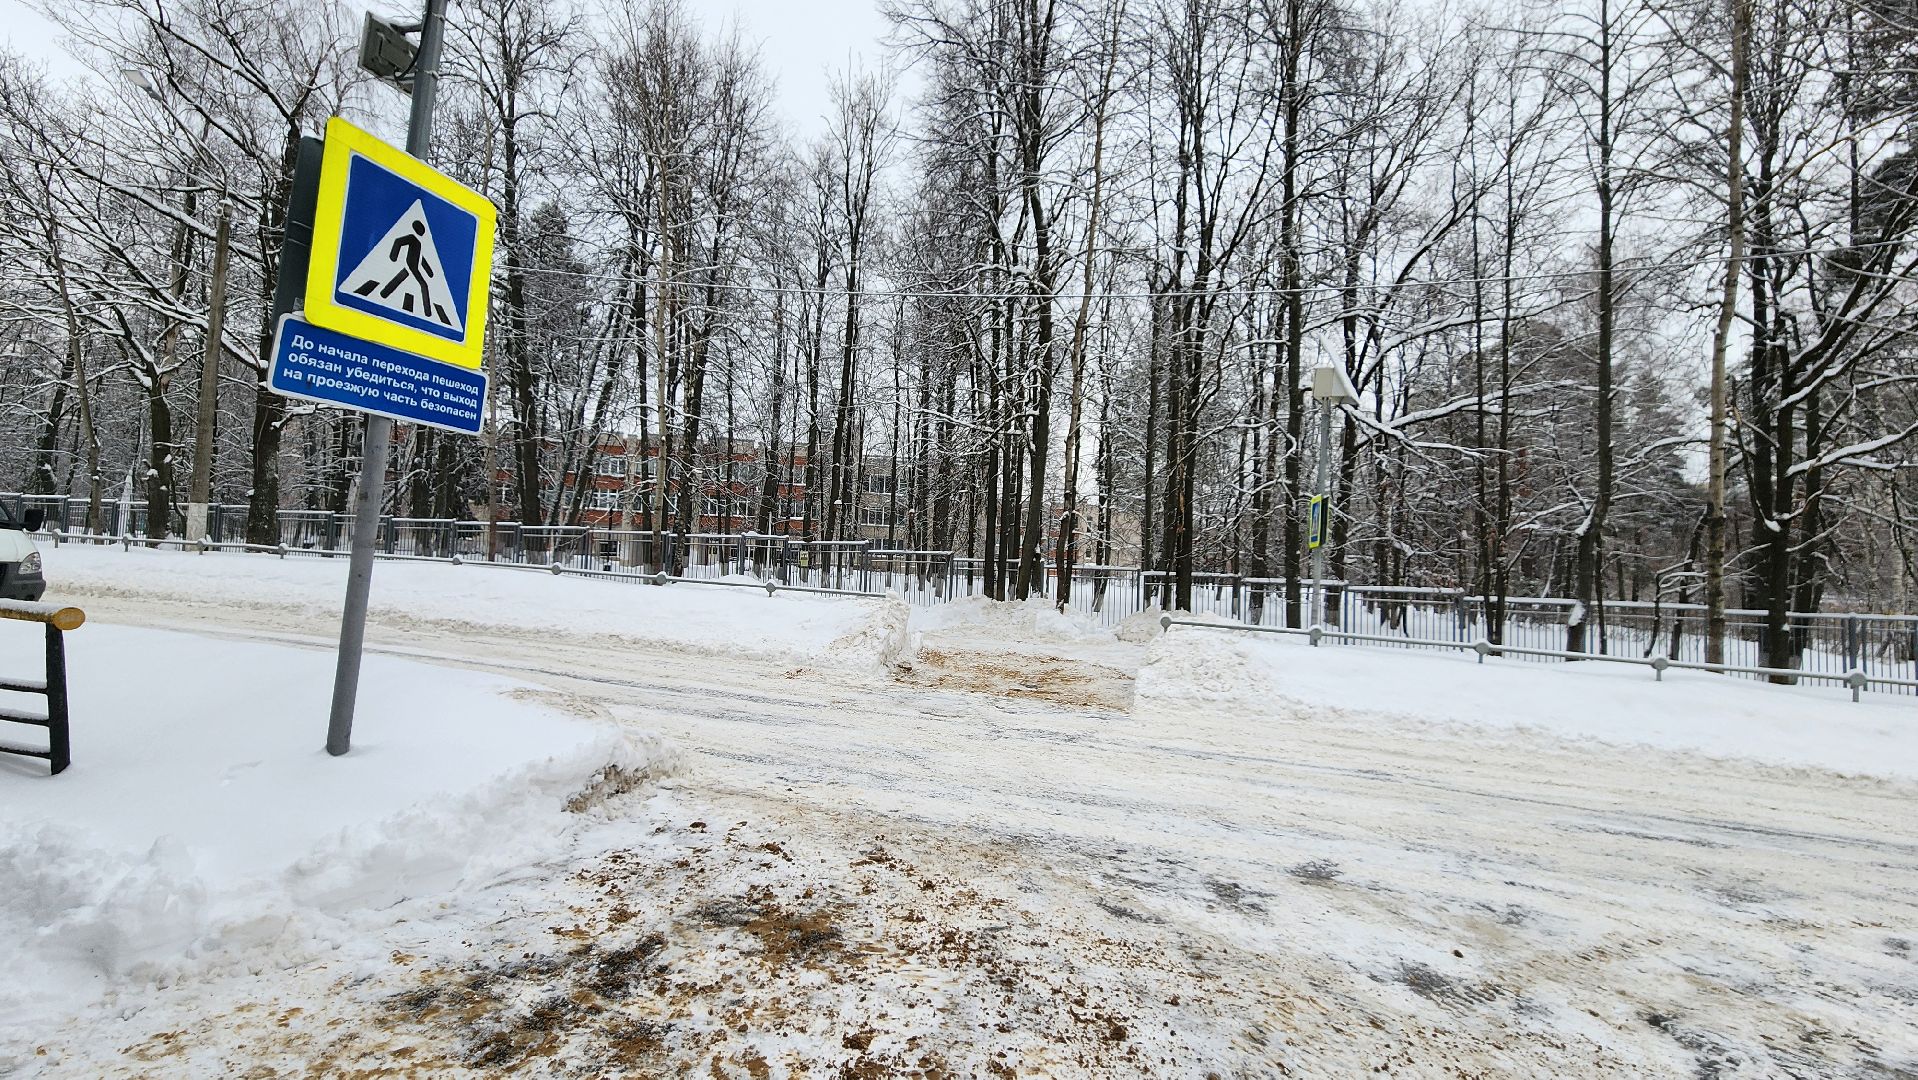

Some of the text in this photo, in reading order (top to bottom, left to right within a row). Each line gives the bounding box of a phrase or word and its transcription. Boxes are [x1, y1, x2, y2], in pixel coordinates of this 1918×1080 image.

[288, 352, 477, 408] обязан убедиться, что выход
[291, 334, 479, 396] До начала перехода пешеход
[283, 368, 477, 421] на проезжую часть безопасен
